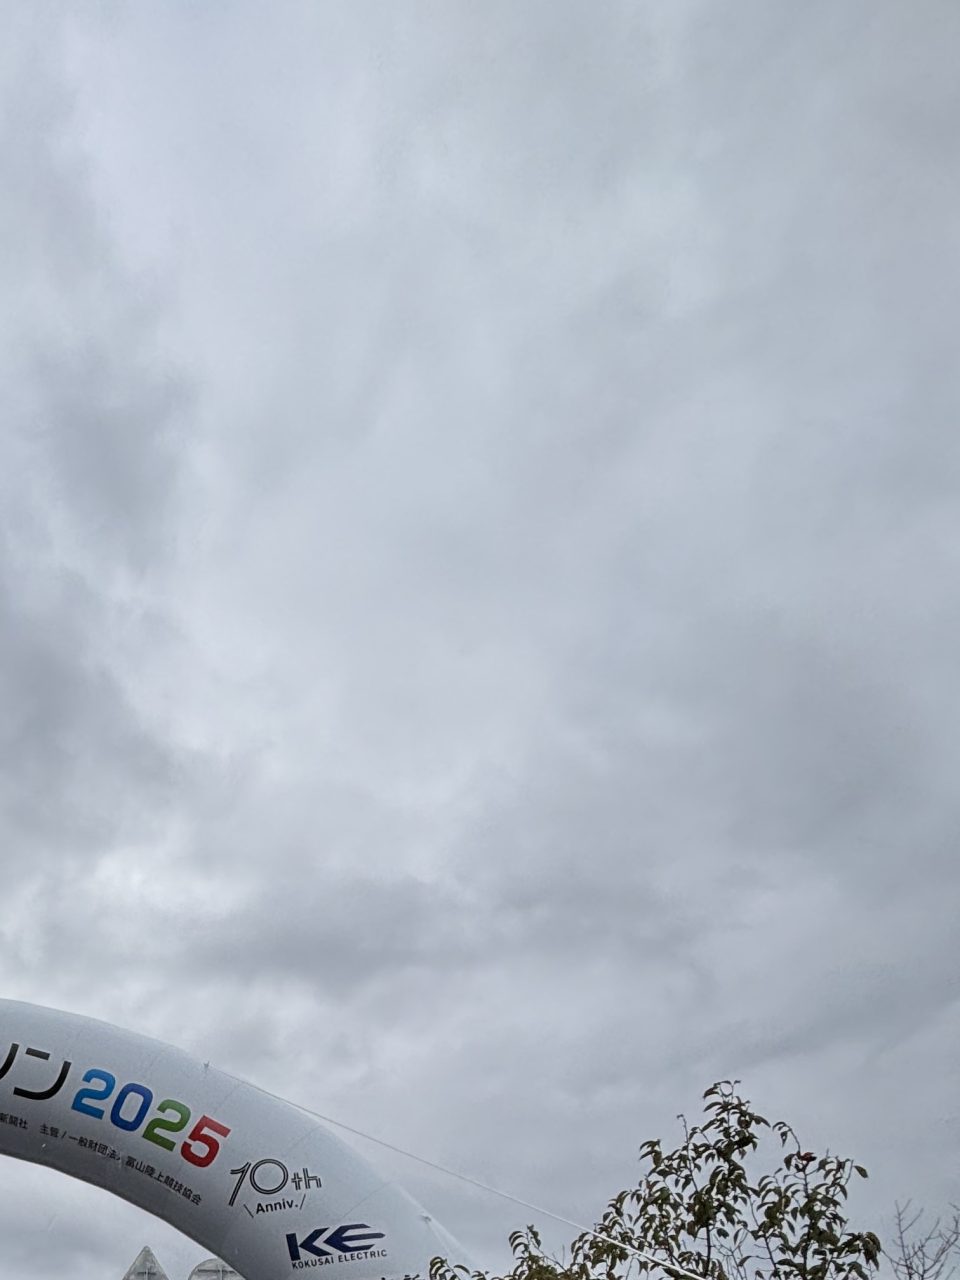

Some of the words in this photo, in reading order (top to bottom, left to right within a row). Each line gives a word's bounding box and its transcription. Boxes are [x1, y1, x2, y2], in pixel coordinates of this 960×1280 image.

[228, 1158, 322, 1207] 10th
[255, 1198, 299, 1215] Anniv.
[291, 1257, 335, 1270] KOKUSAI
[338, 1249, 388, 1263] ELECTRIC
